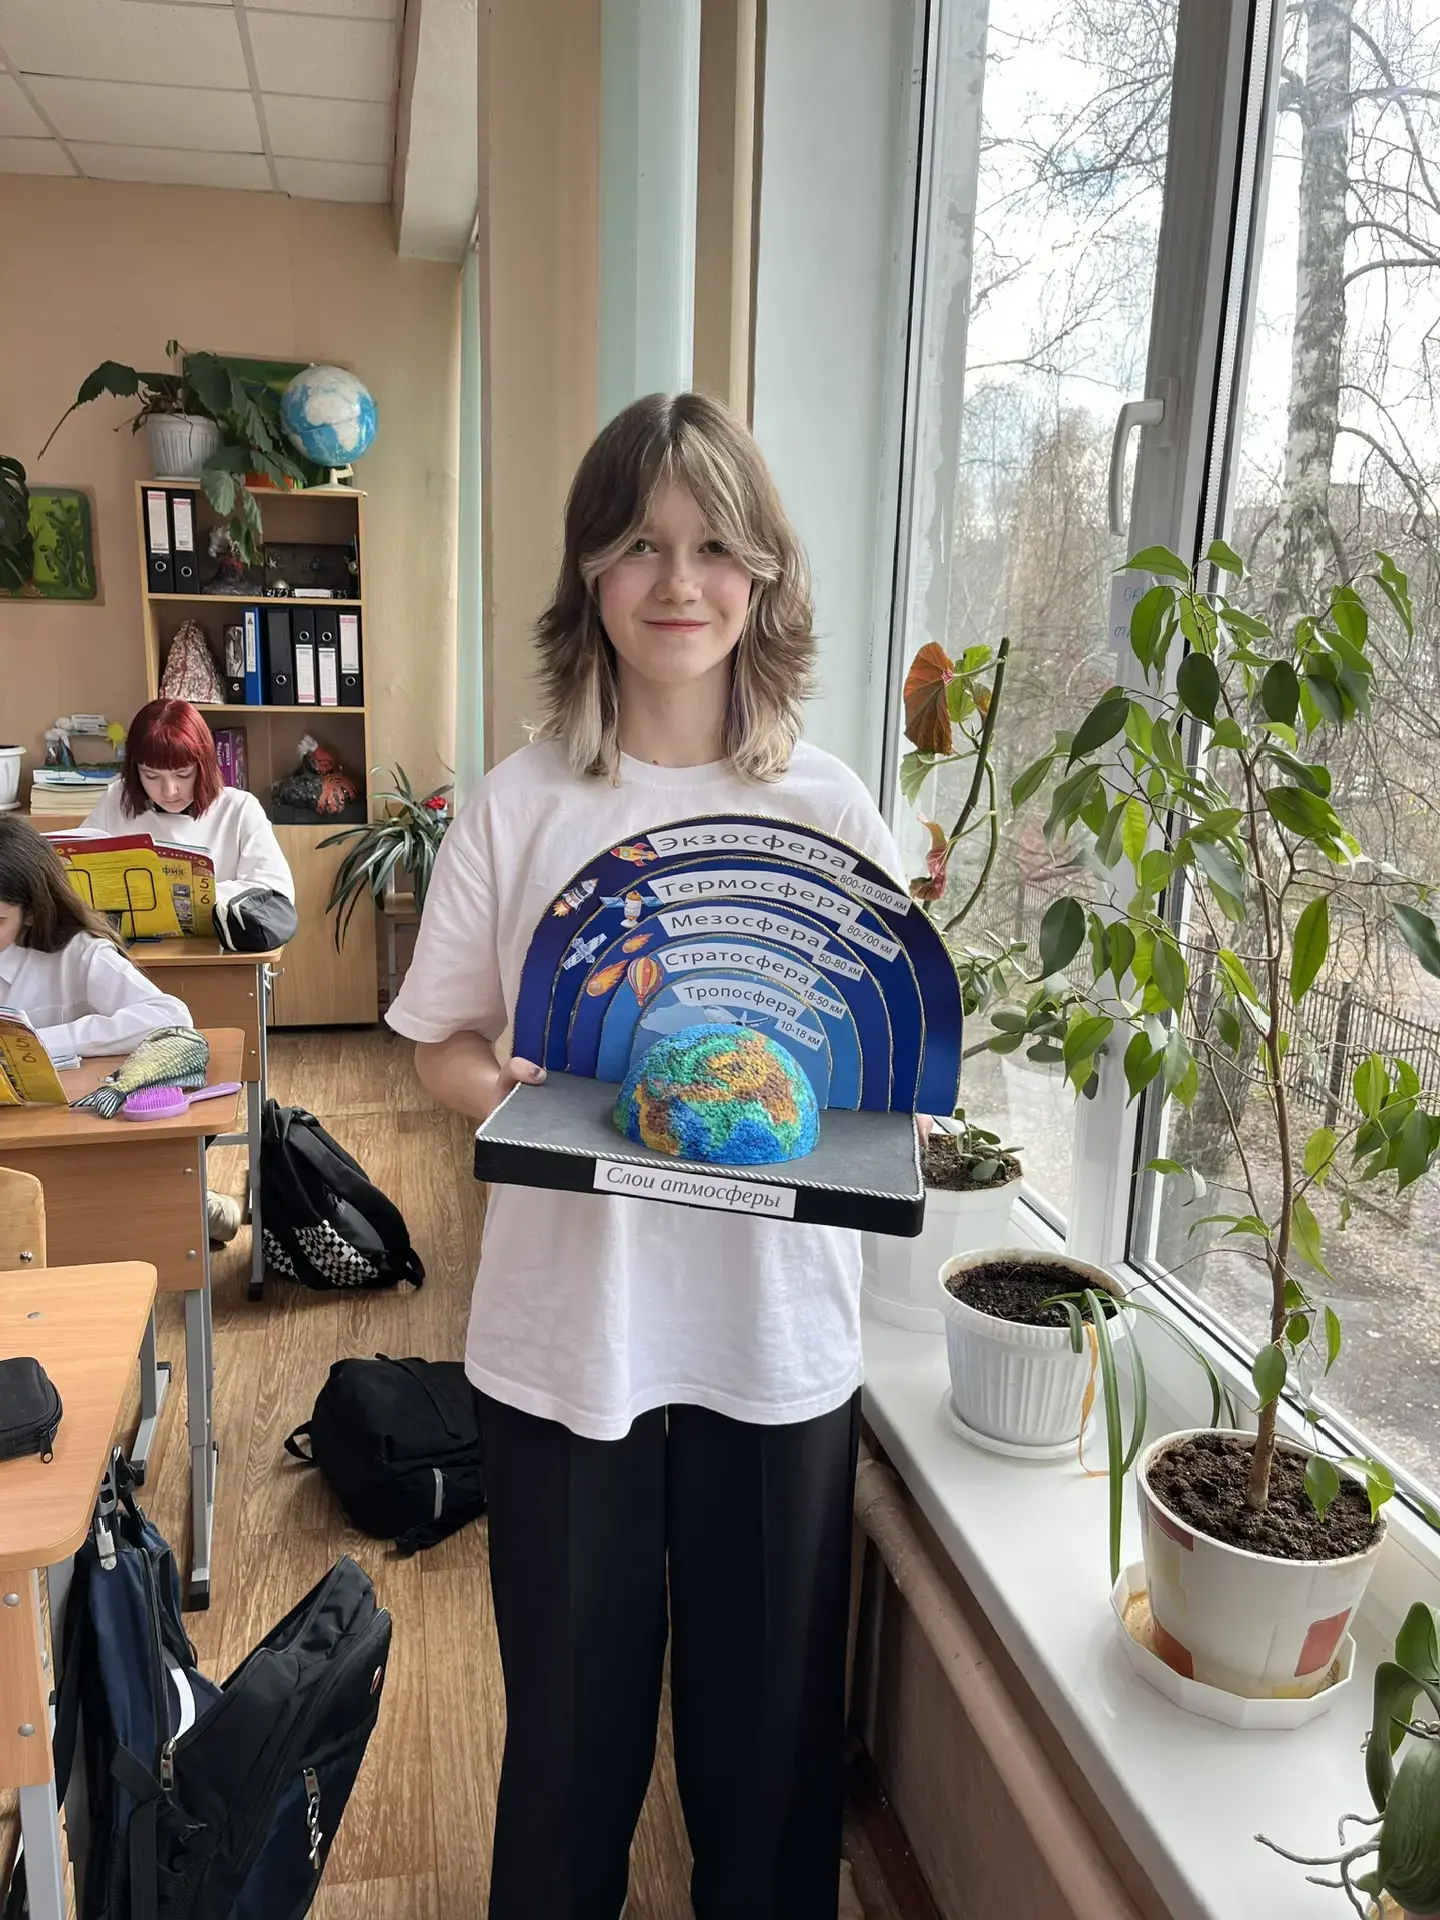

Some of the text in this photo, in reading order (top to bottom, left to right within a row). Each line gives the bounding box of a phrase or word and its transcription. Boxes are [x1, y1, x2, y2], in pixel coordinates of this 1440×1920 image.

[658, 834, 847, 869] Экзосфера
[200, 877, 209, 889] 5
[658, 878, 852, 917] Термосфера
[839, 874, 908, 912] 800-10.000 км
[200, 894, 211, 905] 6
[671, 914, 820, 948] Мезосфера
[847, 924, 893, 956] 80-700 км
[665, 951, 810, 986] Стратосфера
[818, 954, 862, 977] 50-80 км
[684, 986, 797, 1018] Тропосфера
[803, 989, 844, 1015] 18-50 км
[16, 1037, 31, 1048] 5
[781, 1021, 821, 1047] 10-18 км
[22, 1052, 37, 1063] 6
[606, 1167, 781, 1209] Слои атмосферы
